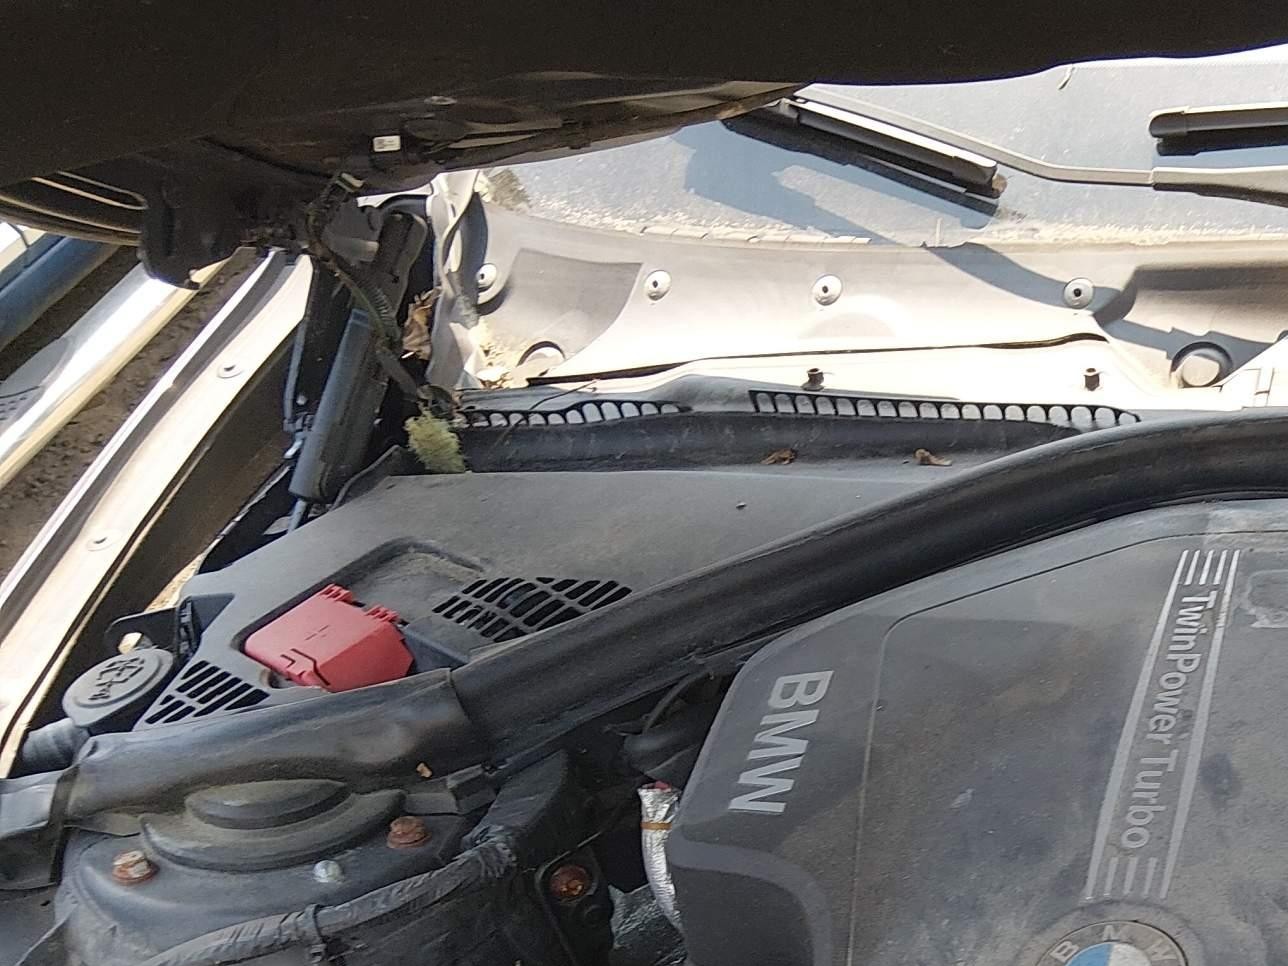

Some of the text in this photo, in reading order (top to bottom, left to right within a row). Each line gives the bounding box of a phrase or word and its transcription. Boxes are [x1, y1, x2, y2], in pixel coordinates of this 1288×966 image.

[727, 669, 835, 814] BMW
[1120, 590, 1217, 850] TwinPower Turbo
[1049, 924, 1178, 963] BMW
